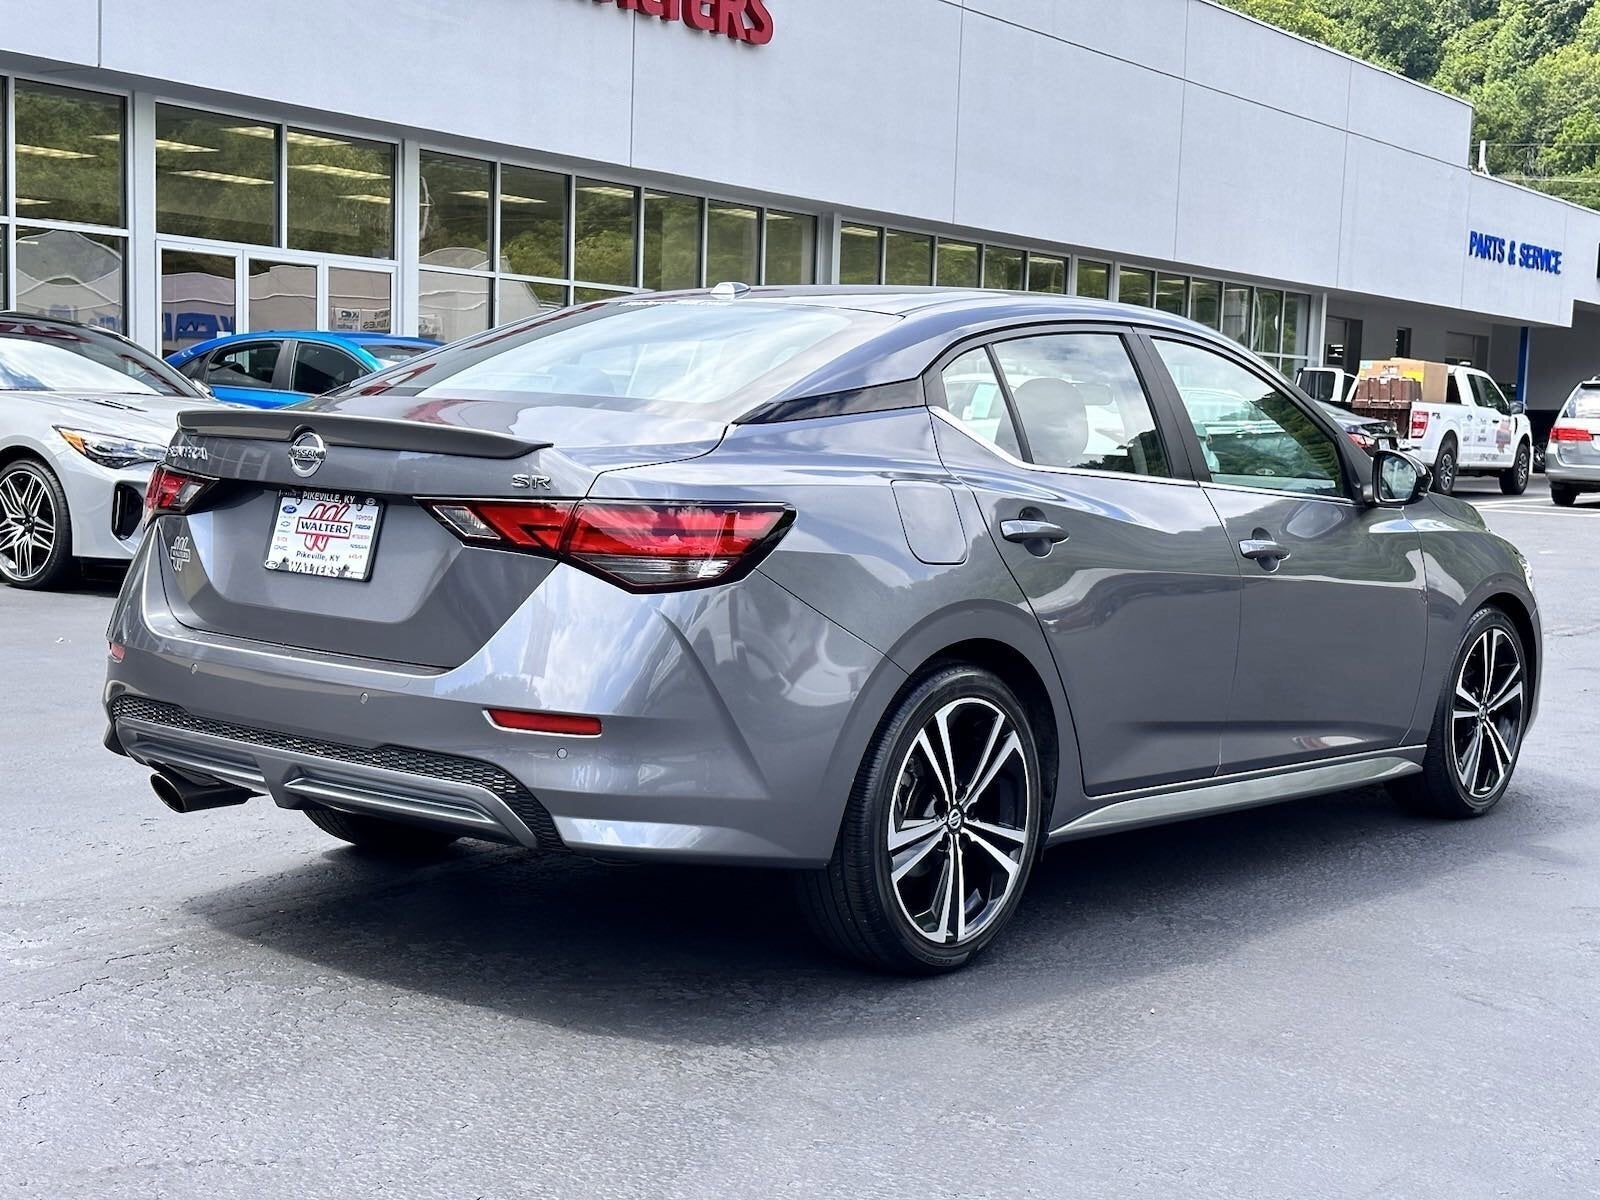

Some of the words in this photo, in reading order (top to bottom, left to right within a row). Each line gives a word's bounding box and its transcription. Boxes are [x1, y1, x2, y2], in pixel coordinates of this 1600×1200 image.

[1469, 230, 1505, 263] PARTS
[1508, 240, 1516, 265] &
[1519, 243, 1562, 275] SERVICE
[511, 473, 551, 490] SR
[303, 491, 342, 504] PIKEVILLE,
[344, 495, 355, 504] KY
[301, 521, 349, 534] WALTERS
[296, 551, 328, 562] Pikeville,
[329, 554, 340, 562] KY
[288, 561, 340, 578] WALTERS
